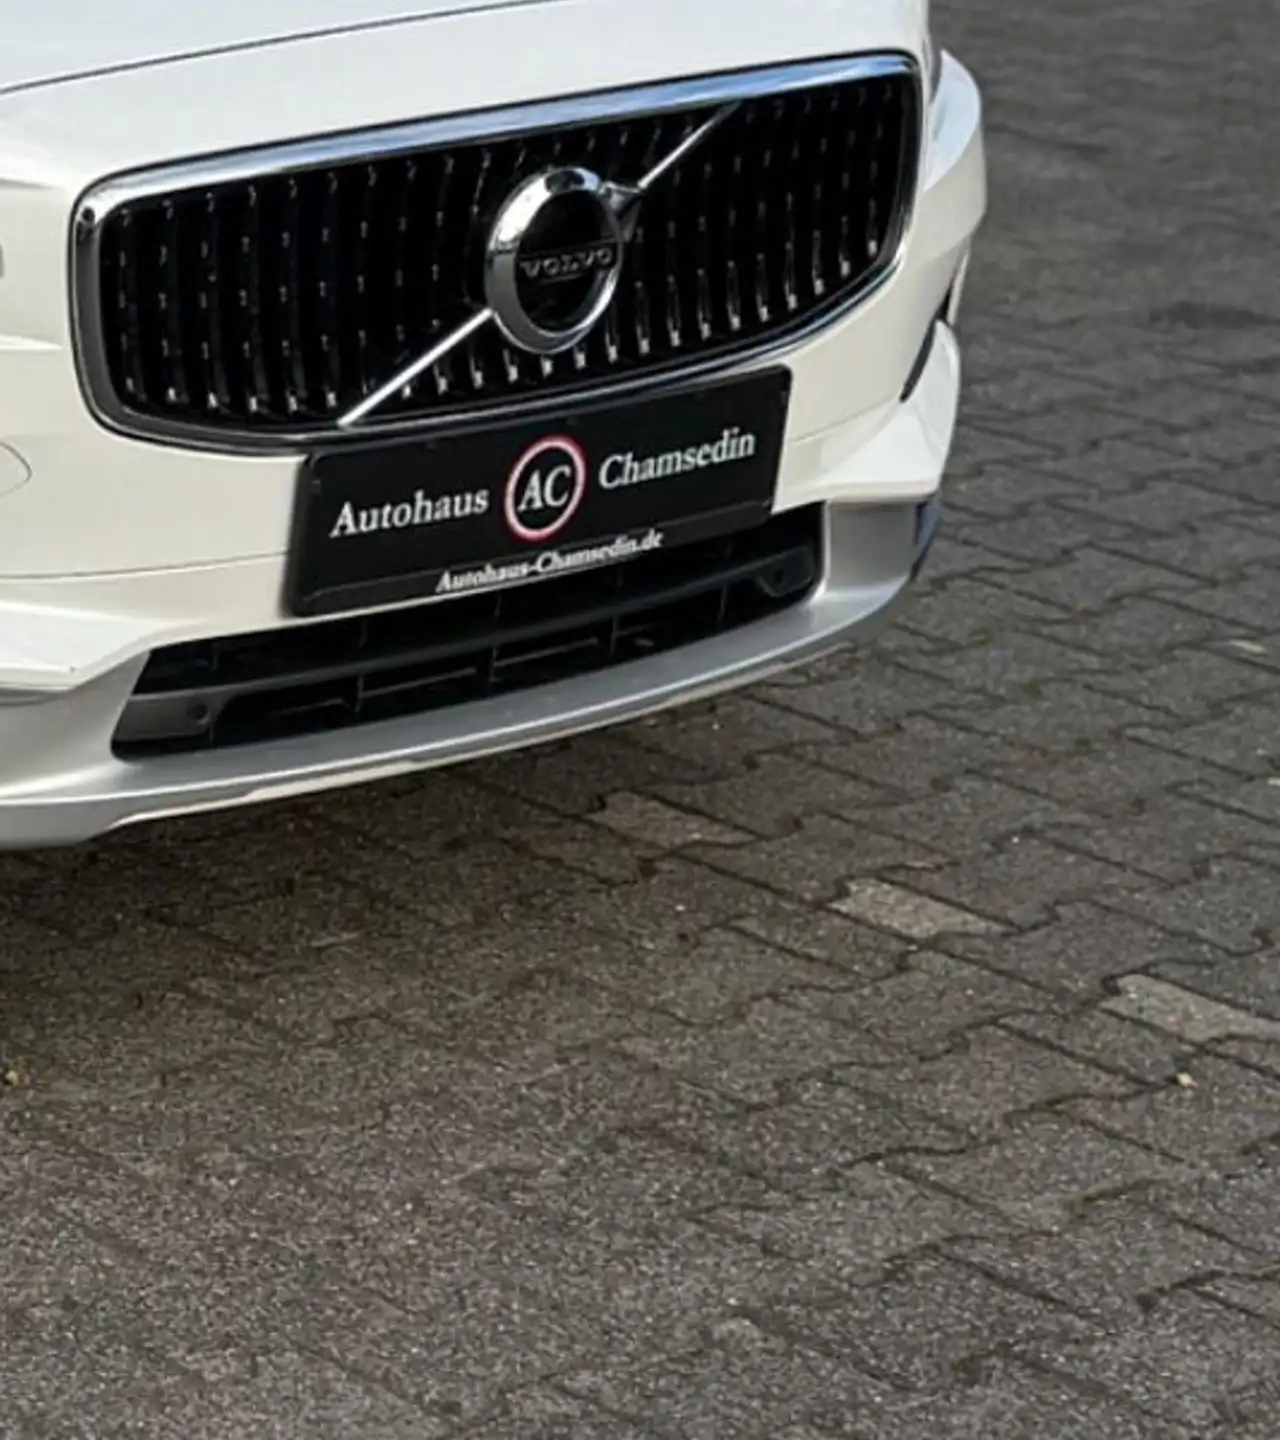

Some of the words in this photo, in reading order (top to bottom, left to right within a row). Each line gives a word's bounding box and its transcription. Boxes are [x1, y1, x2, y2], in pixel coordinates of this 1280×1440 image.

[519, 247, 612, 278] VOLVO
[329, 489, 490, 538] Autohaus
[517, 465, 572, 512] AC
[598, 426, 756, 489] Chamsedin
[436, 528, 664, 593] Autohaus-Chamsedin.de
